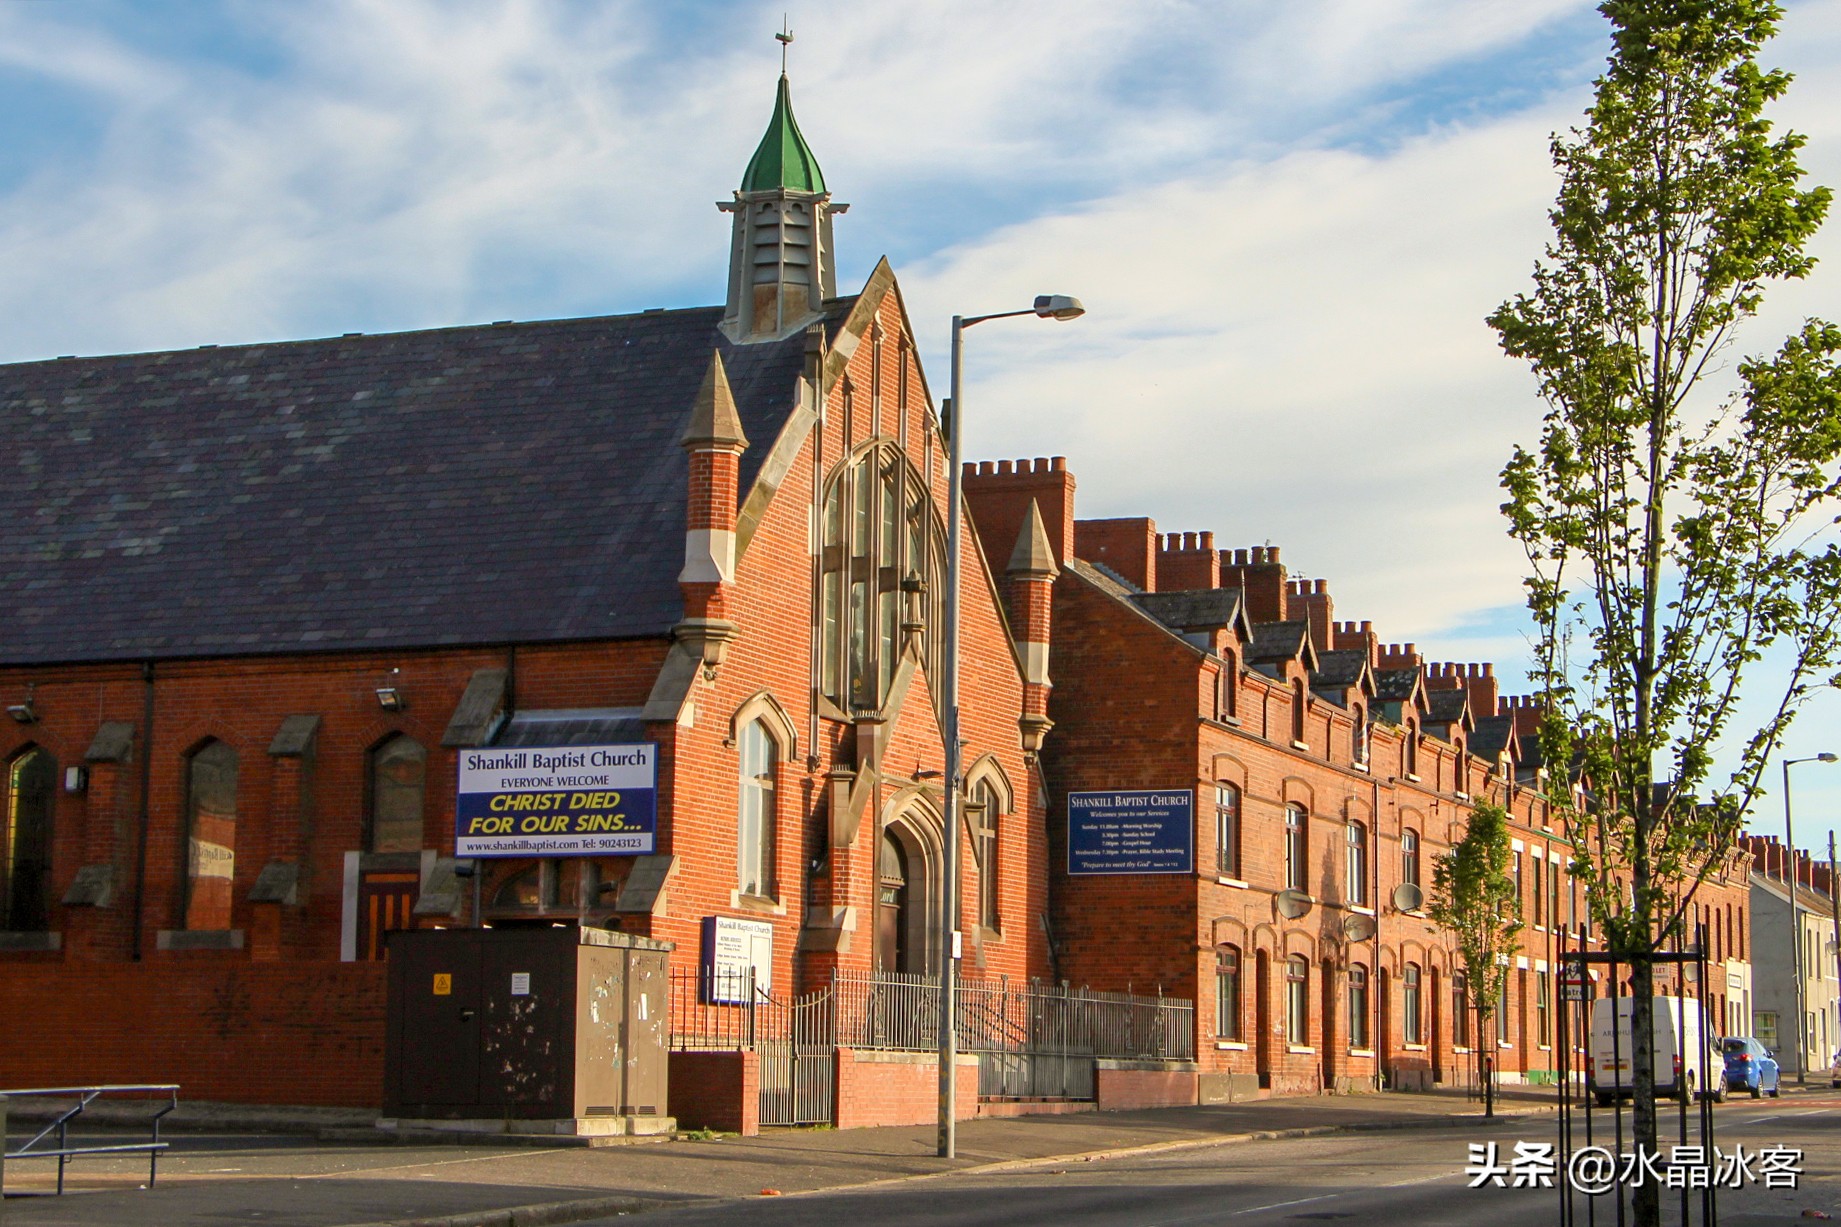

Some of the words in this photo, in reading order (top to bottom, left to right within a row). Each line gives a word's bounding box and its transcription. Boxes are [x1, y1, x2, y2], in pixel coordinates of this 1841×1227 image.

[468, 753, 527, 771] Shankill
[533, 752, 585, 773] Baptist
[591, 749, 646, 767] Church
[501, 777, 553, 788] EVERYONE
[557, 775, 609, 787] WELCOME
[490, 793, 566, 811] CHRIST
[569, 791, 620, 809] DIED
[1071, 797, 1113, 808] SHANKILL
[1115, 796, 1149, 807] BAPTIST
[1150, 794, 1188, 806] CHURCH
[469, 817, 514, 834] FOR
[520, 815, 570, 832] OUR
[575, 814, 642, 831] SINS...
[467, 840, 579, 852] www.shankillbaptist.com
[582, 839, 596, 849] Tel:
[599, 838, 642, 849] 90243123
[718, 921, 737, 930] Shankill
[737, 923, 754, 932] Baptist
[754, 924, 771, 934] Church
